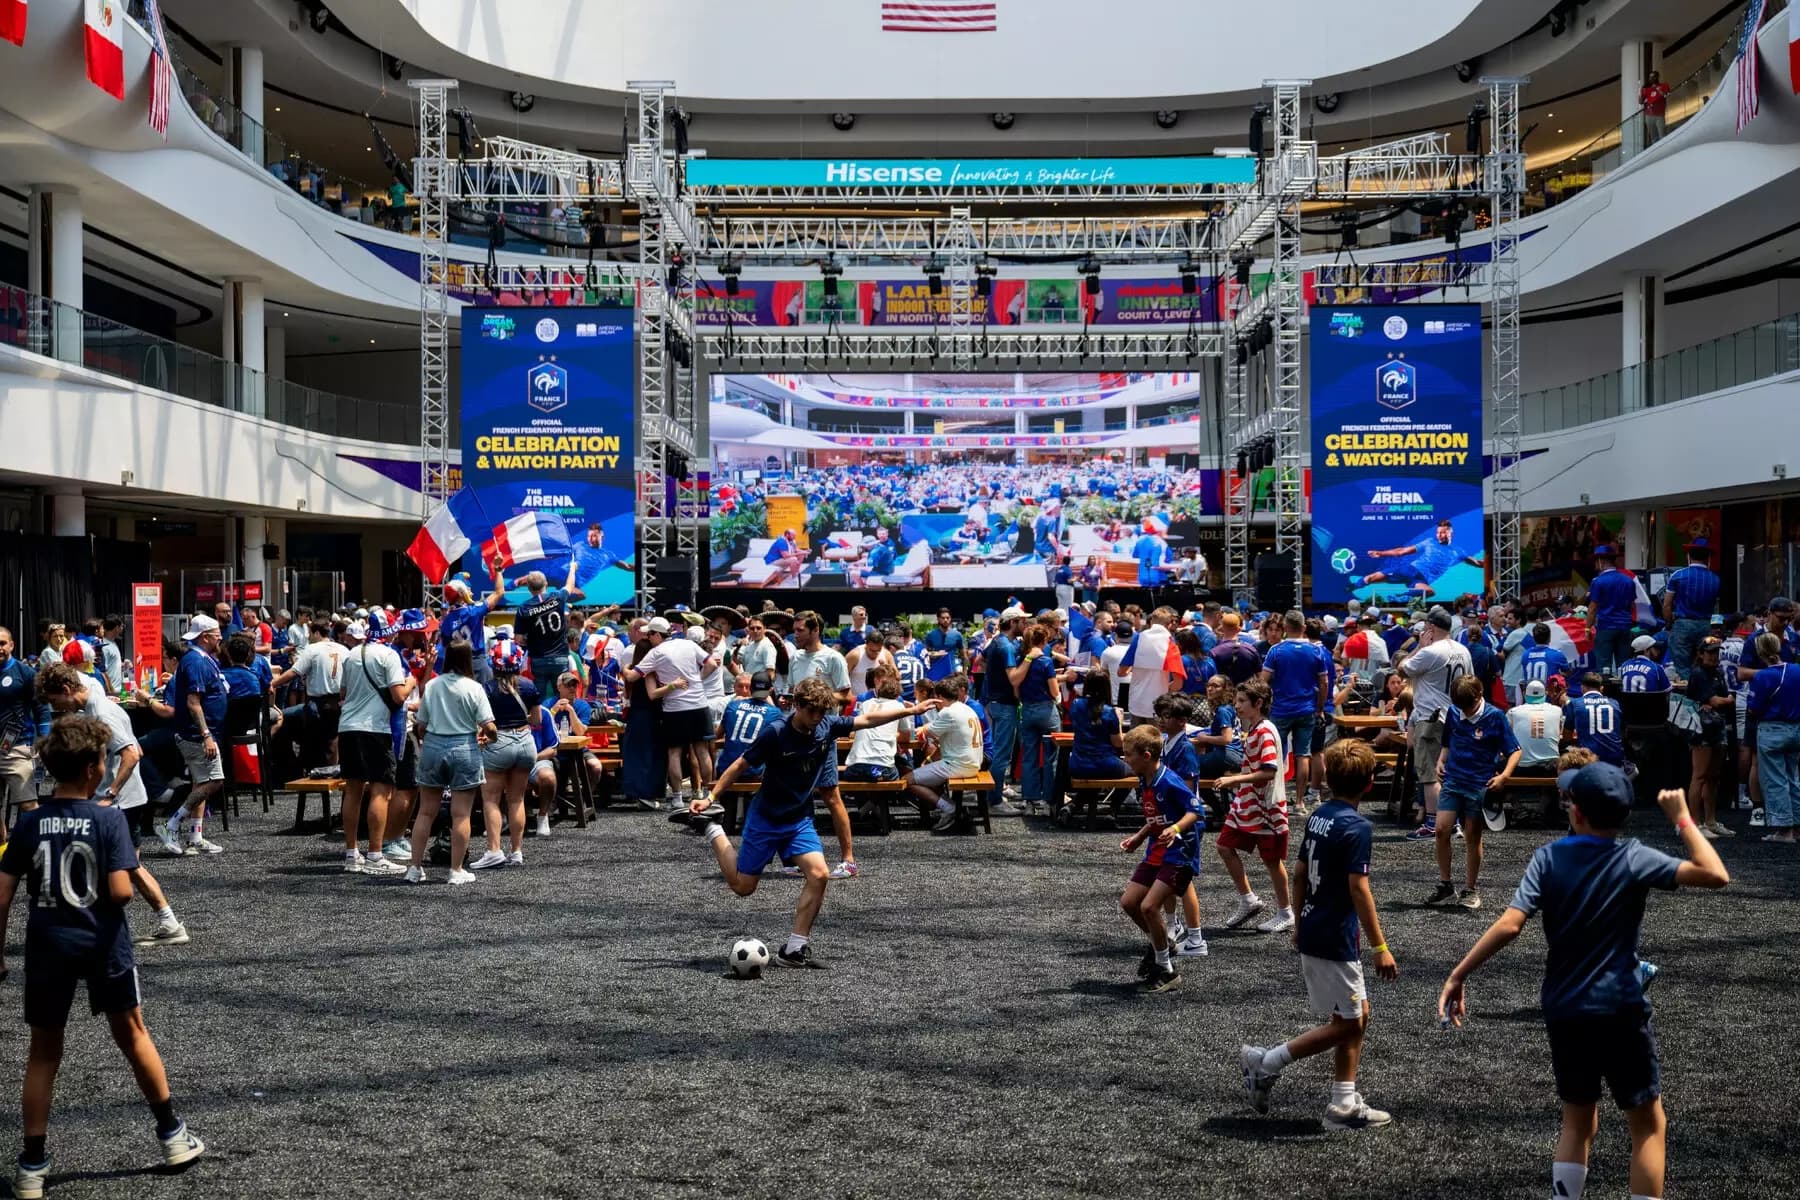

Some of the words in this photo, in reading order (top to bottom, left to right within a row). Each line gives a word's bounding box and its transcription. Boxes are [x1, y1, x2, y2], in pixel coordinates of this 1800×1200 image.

[826, 163, 942, 182] Hisense
[950, 163, 1019, 184] Innovating
[1038, 168, 1088, 184] Brighter
[1091, 166, 1115, 182] Life
[886, 300, 925, 313] INDOOR
[1118, 295, 1200, 310] UNIVERSE
[886, 314, 898, 323] IN
[1117, 311, 1151, 321] COURT
[476, 436, 620, 452] CELEBRATION
[1325, 433, 1468, 450] CELEBRATION
[476, 455, 490, 469] &
[494, 455, 556, 468] WATCH
[560, 455, 620, 468] PARTY
[1325, 453, 1339, 466] &
[1343, 453, 1406, 466] WATCH
[1409, 452, 1468, 465] PARTY
[521, 495, 575, 507] ARENA
[1370, 492, 1424, 504] ARENA
[529, 600, 559, 616] FRANCE
[535, 611, 562, 635] 10
[897, 660, 925, 684] 20
[1526, 661, 1549, 682] 10
[1622, 664, 1651, 675] ZIDANE
[1445, 662, 1466, 694] 10
[731, 709, 763, 744] 10
[1585, 704, 1614, 735] 10
[39, 816, 91, 835] MBAPPE
[1146, 814, 1174, 827] PEL
[31, 840, 98, 908] 10
